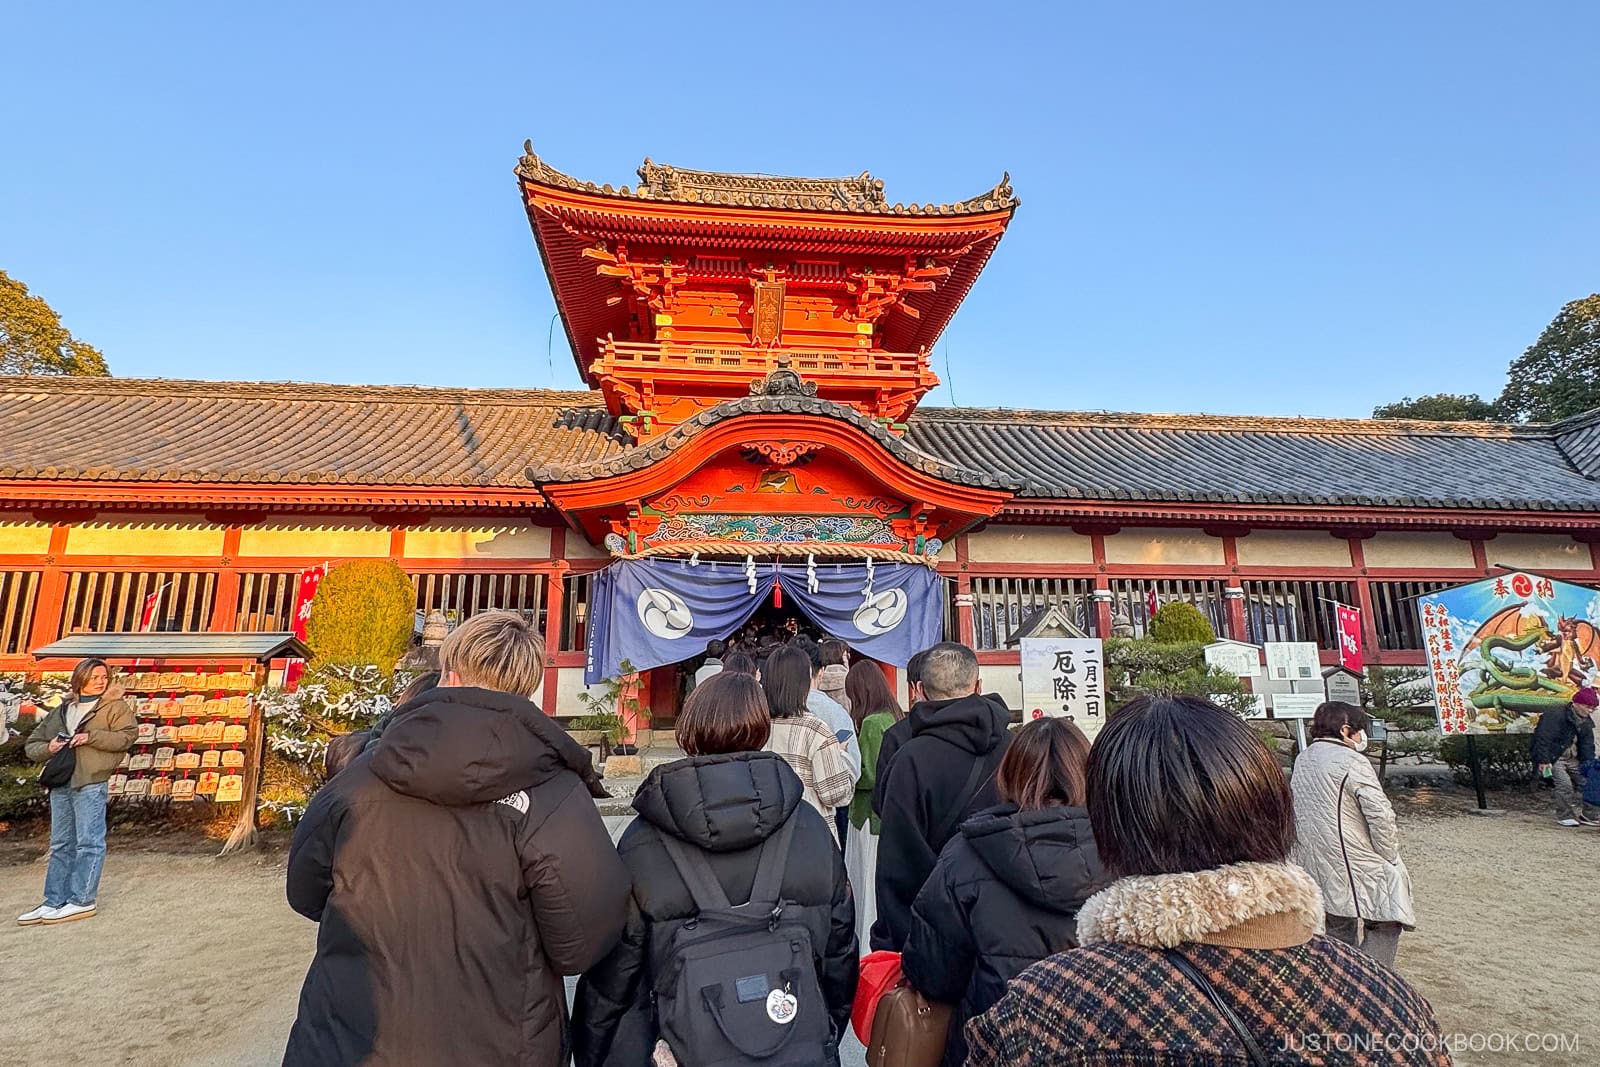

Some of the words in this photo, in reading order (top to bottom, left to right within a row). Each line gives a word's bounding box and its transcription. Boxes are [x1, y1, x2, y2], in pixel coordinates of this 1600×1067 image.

[1052, 650, 1077, 722] 厄除・
[1082, 649, 1100, 717] 二月三日
